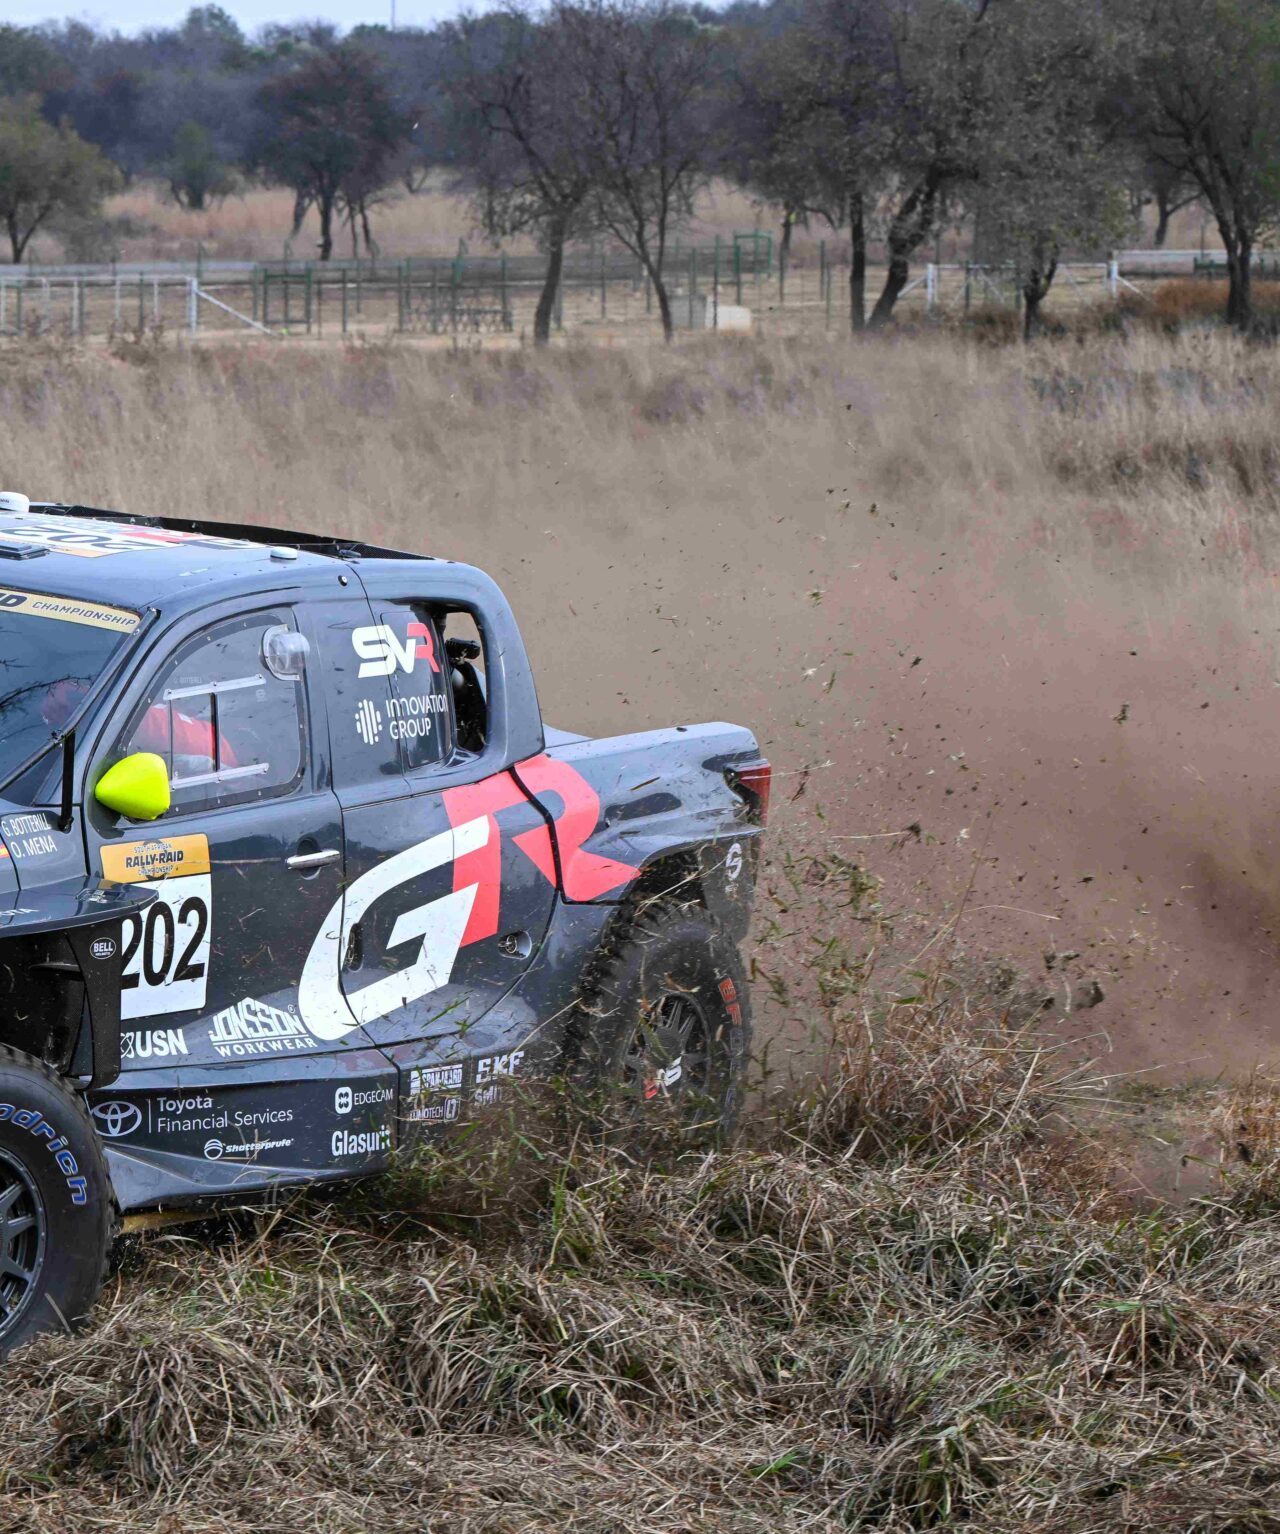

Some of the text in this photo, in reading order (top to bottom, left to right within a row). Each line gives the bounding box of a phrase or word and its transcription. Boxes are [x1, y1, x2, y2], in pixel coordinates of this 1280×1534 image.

[32, 601, 136, 627] CHAMPIONSHIP
[351, 622, 440, 678] SVR
[389, 718, 432, 739] GROUP
[9, 812, 52, 837] BOTTERILL
[10, 835, 58, 858] O. MENA
[126, 850, 183, 868] RALLY-RAID
[298, 753, 641, 1041] GR
[93, 942, 114, 953] BELL
[121, 896, 208, 990] 202
[208, 996, 307, 1042] JONSSON
[135, 1029, 188, 1058] USN
[214, 1038, 318, 1058] WORKWEAR
[157, 1096, 214, 1115] Toyota
[354, 1088, 393, 1106] EDGECAM
[157, 1108, 293, 1133] Financial Services
[225, 1139, 293, 1153] Shatterprufe
